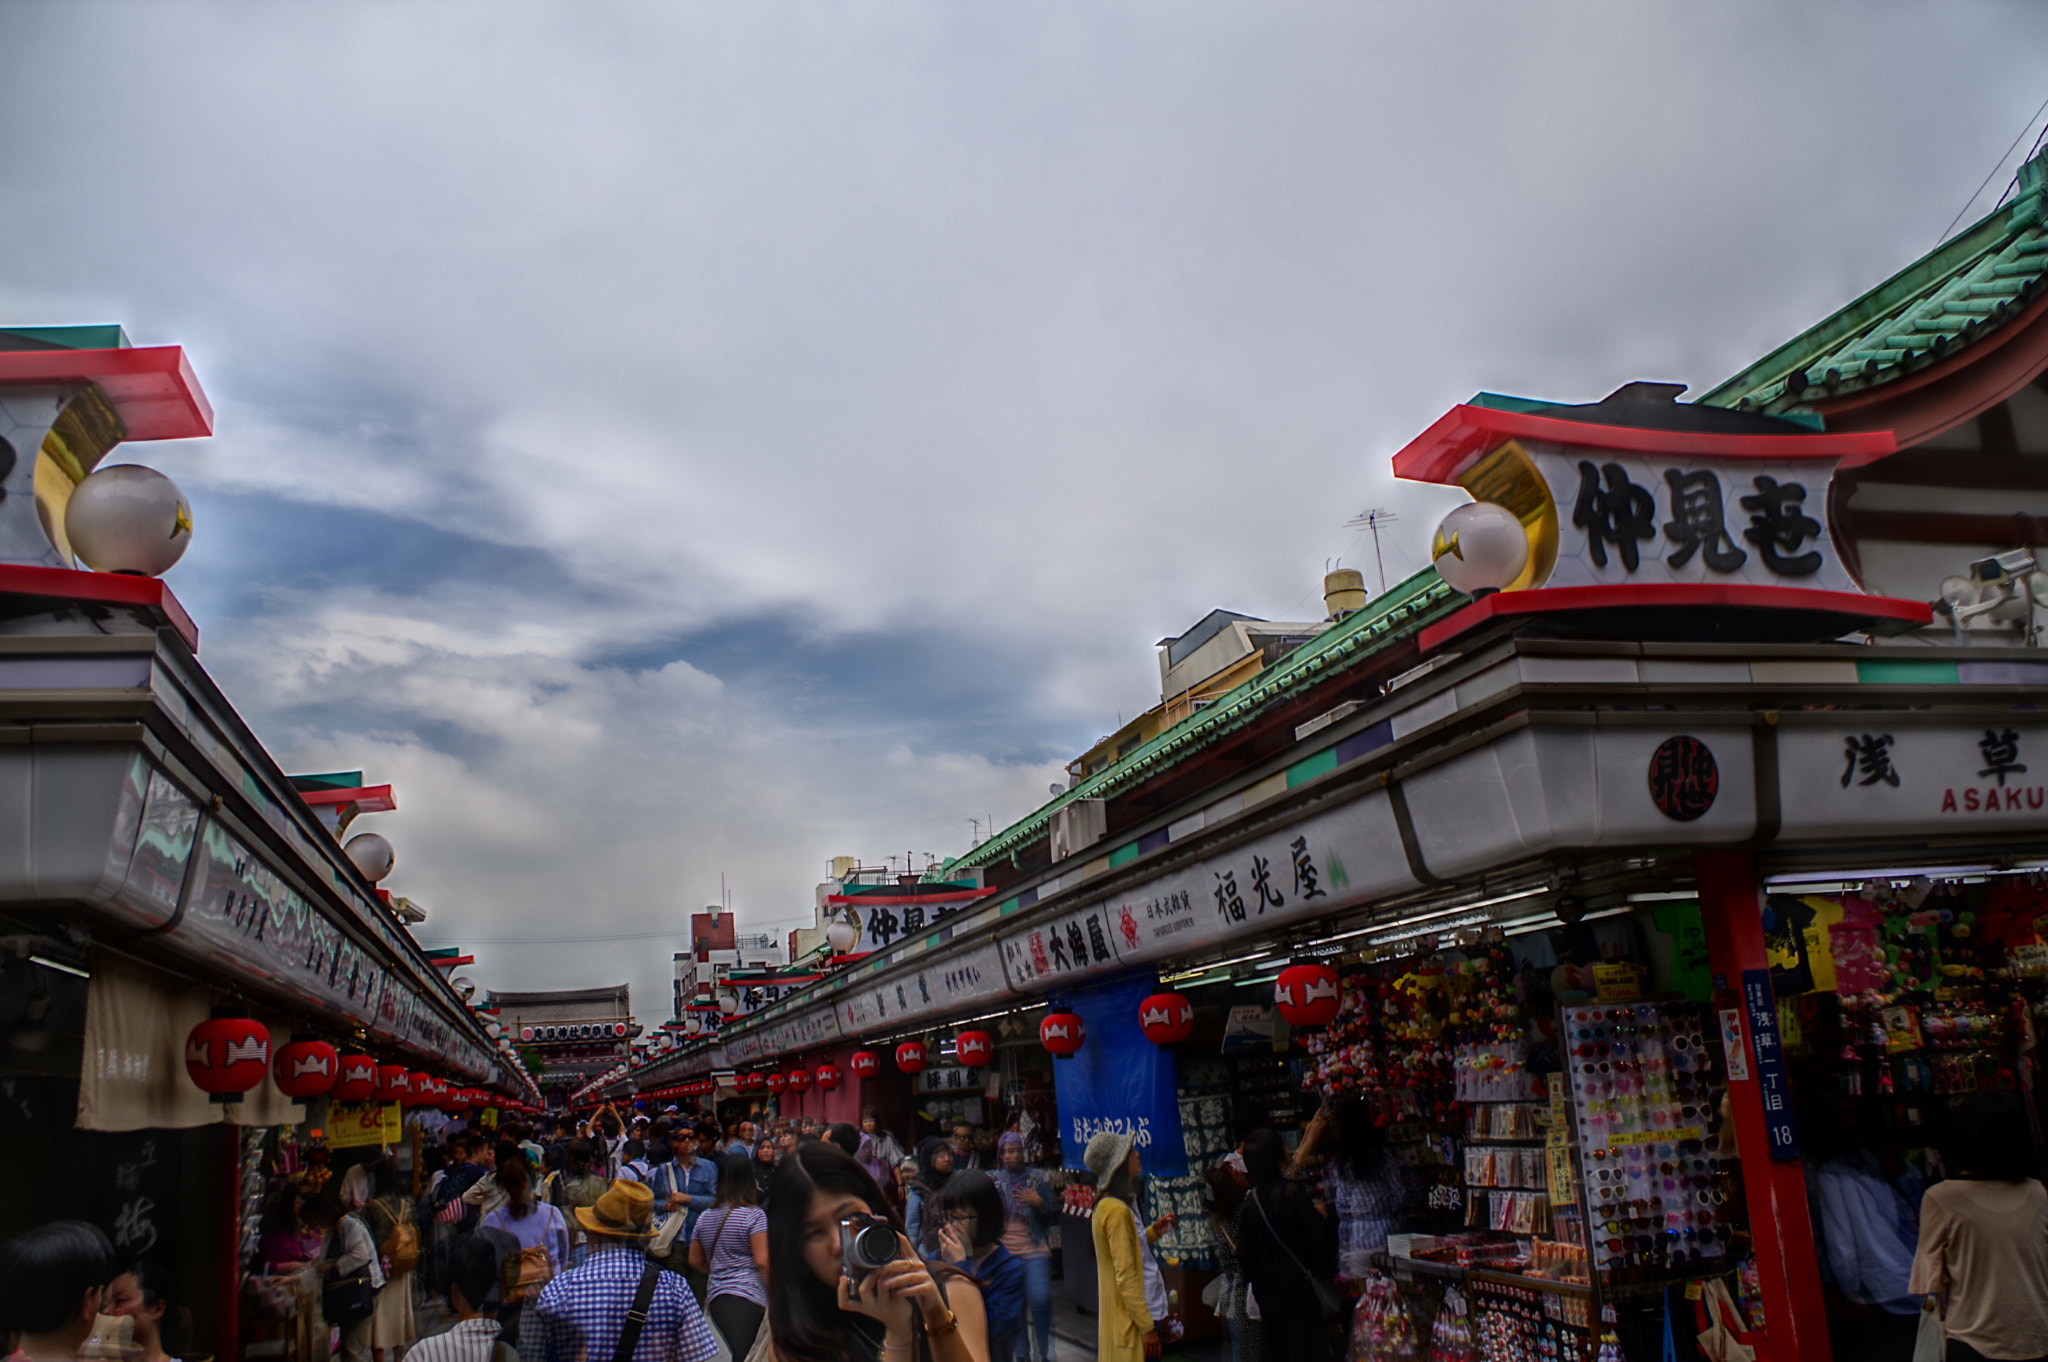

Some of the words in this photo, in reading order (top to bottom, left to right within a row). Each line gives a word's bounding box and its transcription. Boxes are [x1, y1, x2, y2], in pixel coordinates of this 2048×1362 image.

[1573, 460, 1822, 576] 仲見世
[1841, 728, 2027, 788] 浅草
[1942, 787, 2048, 813] ASAKU
[1214, 836, 1326, 924] 福光屋
[1773, 1125, 1793, 1147] 18
